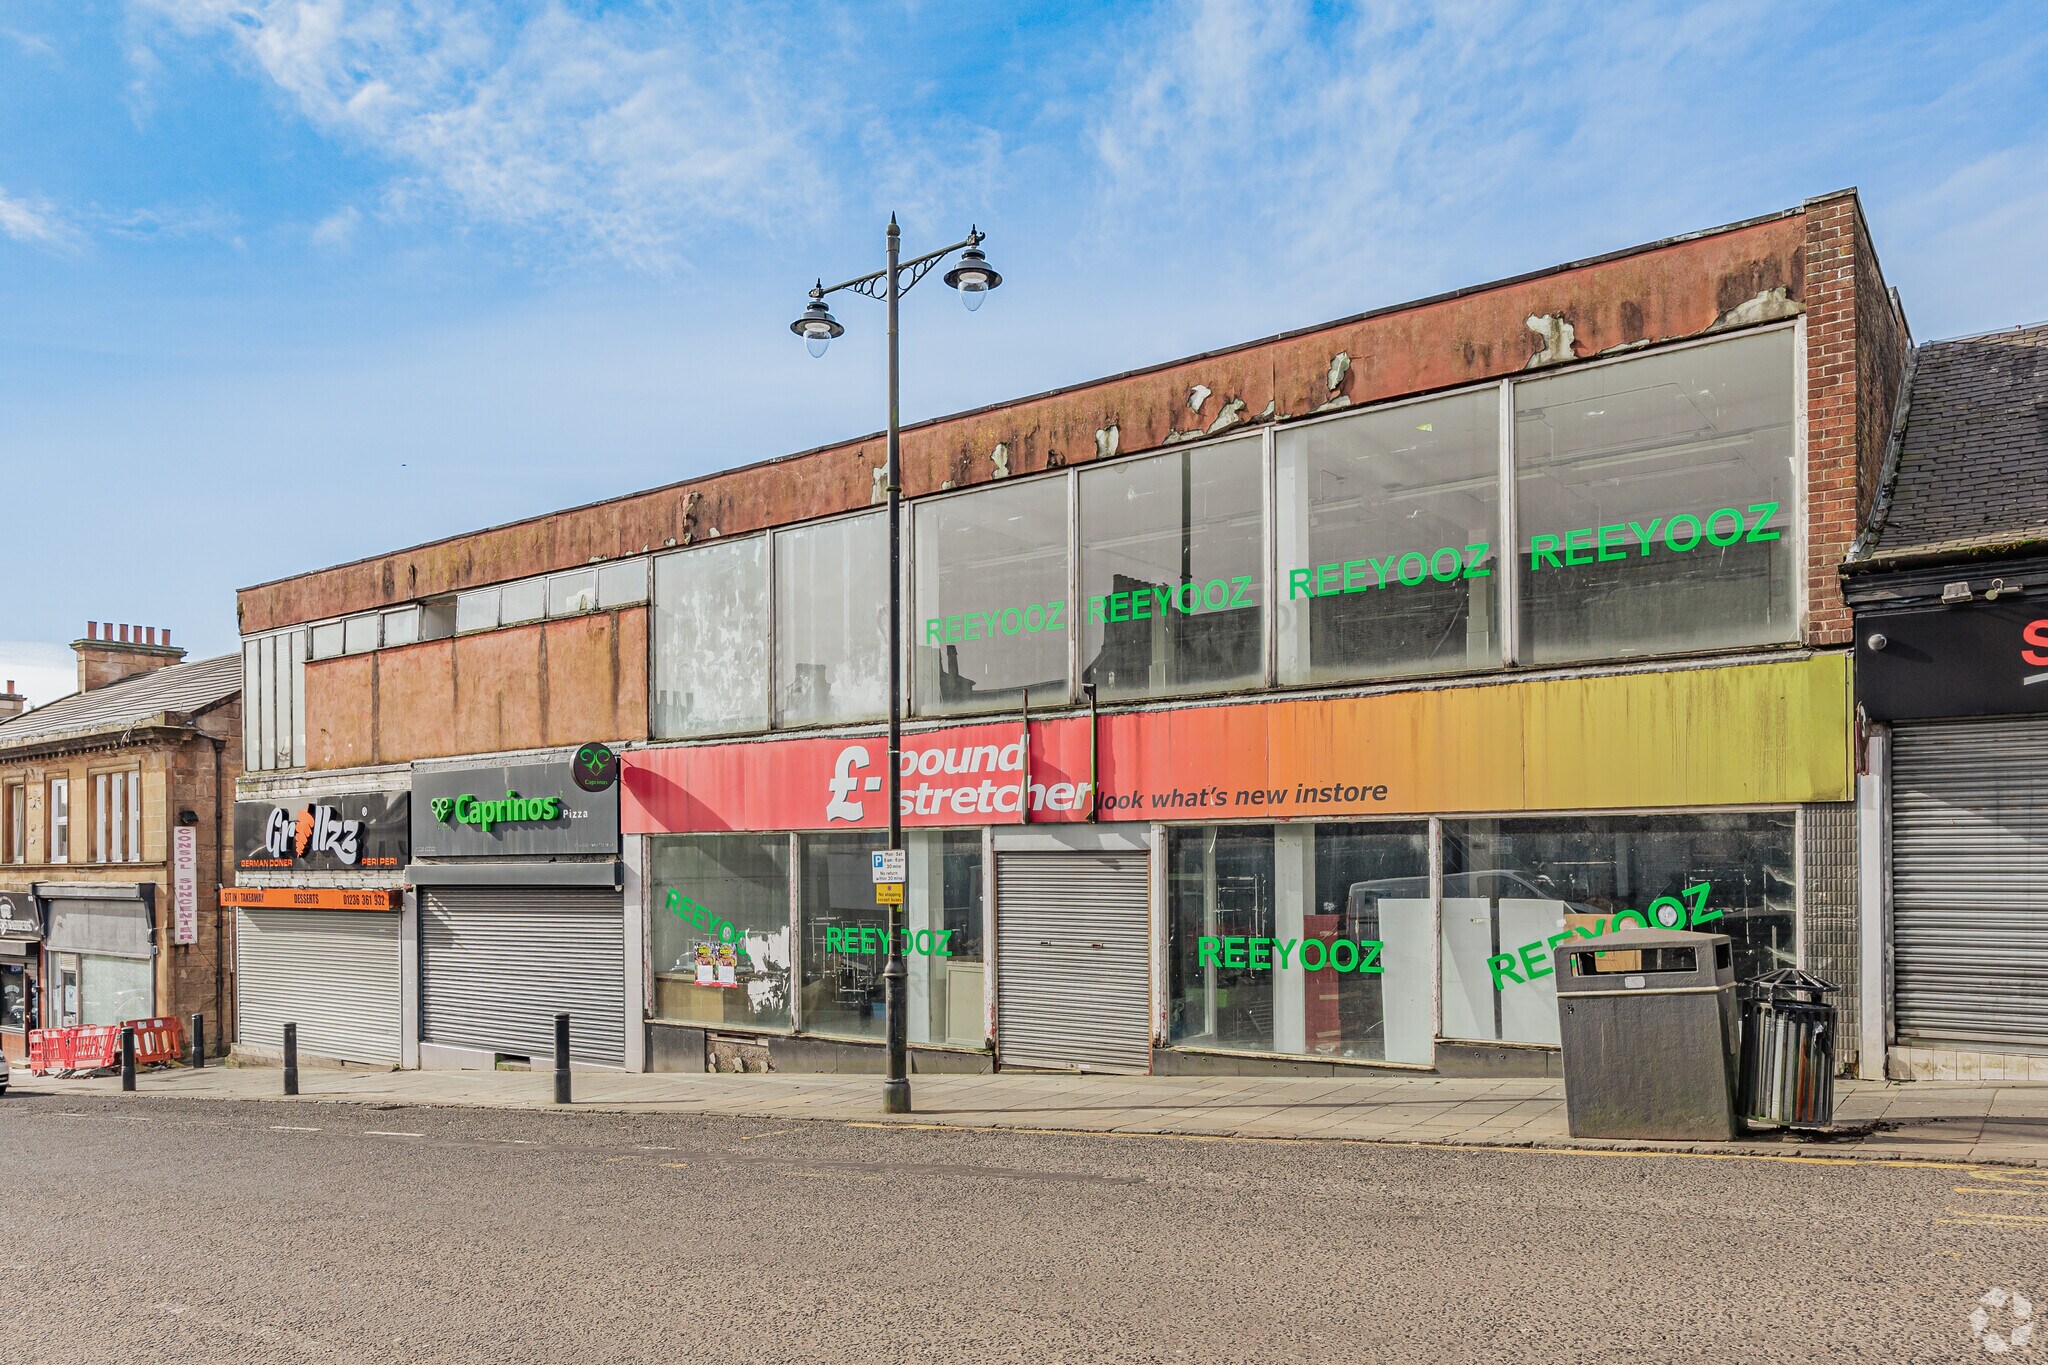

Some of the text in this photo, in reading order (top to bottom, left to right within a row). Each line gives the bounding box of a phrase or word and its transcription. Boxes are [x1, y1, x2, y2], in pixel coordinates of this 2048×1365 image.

[1530, 501, 1780, 571] REEYOOZ
[1289, 542, 1491, 600] REEYOOZ
[1087, 575, 1252, 625] REEYOOZ
[926, 600, 1065, 645] REEYOOZ
[585, 778, 609, 786] Caprinos
[454, 790, 559, 832] Caprinos
[1098, 783, 1388, 811] look what's new instore
[562, 808, 588, 819] Pizza
[240, 858, 268, 867] GERMAN
[361, 857, 398, 866] PERI PERI
[224, 892, 264, 903] SIT IN TAKEAWAY
[293, 893, 320, 904] DESSERTS
[343, 894, 385, 906] 01236 361 932
[665, 886, 751, 961] REEYOO
[825, 926, 953, 957] REEYOOZ
[1197, 935, 1385, 974] REEYOOZ
